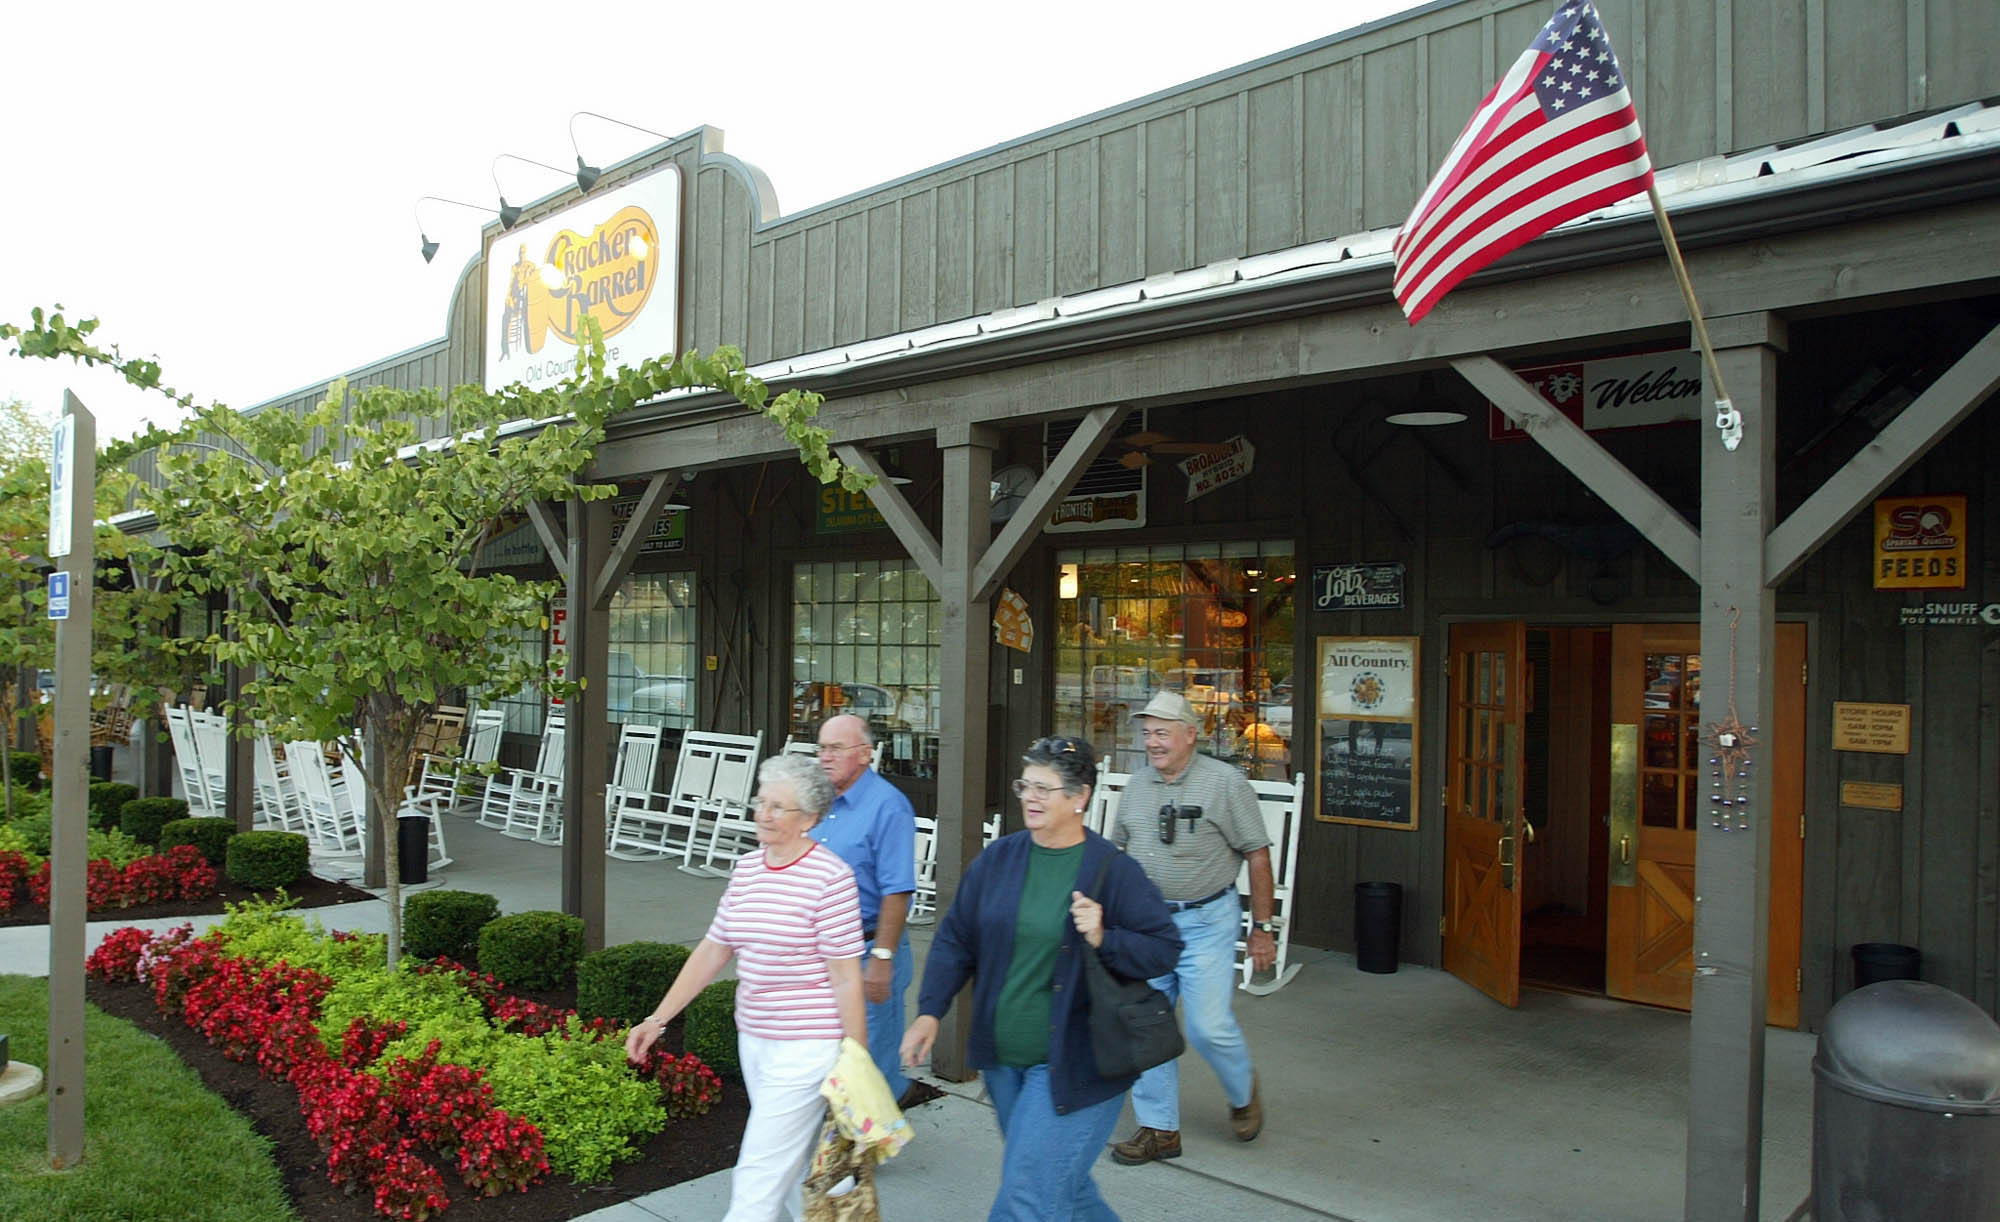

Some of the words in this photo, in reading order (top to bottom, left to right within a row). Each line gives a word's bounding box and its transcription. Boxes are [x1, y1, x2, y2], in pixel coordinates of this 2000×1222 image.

[548, 226, 637, 276] Cracker
[549, 261, 646, 339] Barrel
[526, 364, 542, 383] Old
[546, 357, 577, 378] Count
[1055, 502, 1094, 521] FRONTIER
[1890, 505, 1953, 537] SQ
[1881, 557, 1957, 578] FEEDS
[1344, 593, 1400, 606] BEVERAGES
[1901, 607, 1924, 615] THAT
[1925, 603, 1978, 615] SNUFF
[1900, 617, 1926, 625] YOU
[1929, 617, 1962, 625] WANT
[1966, 617, 1977, 625] IS
[1327, 655, 1348, 667] All
[1351, 655, 1410, 671] Country.
